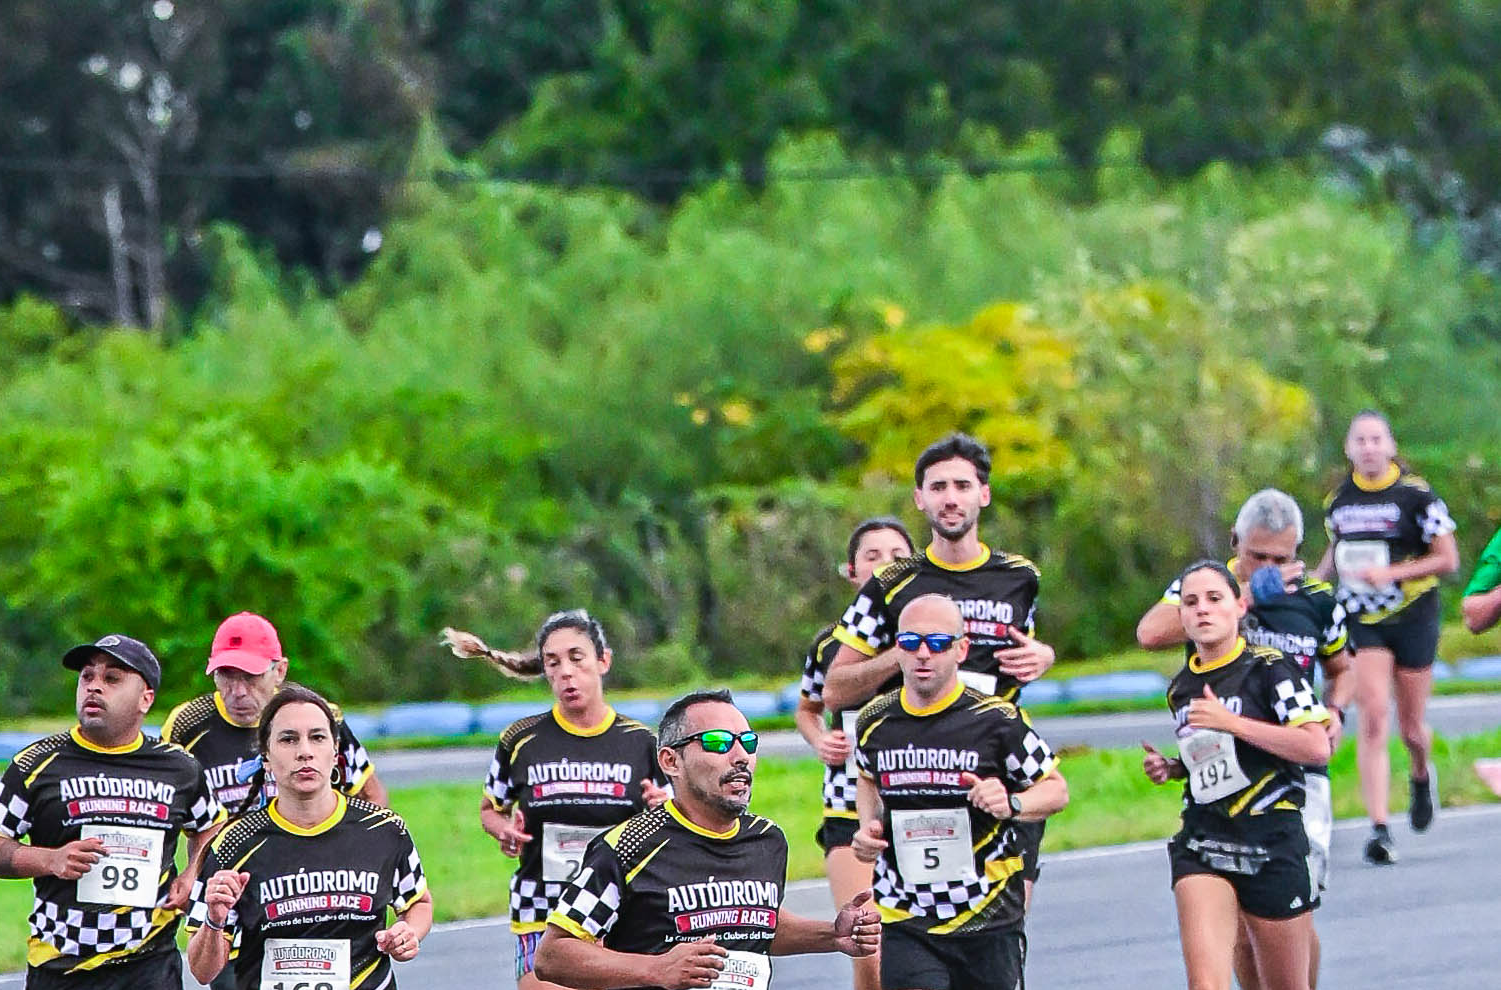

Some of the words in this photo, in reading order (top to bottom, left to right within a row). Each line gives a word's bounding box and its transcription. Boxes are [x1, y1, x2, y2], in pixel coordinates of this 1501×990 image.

[877, 743, 979, 772] AUTÓDROMO
[527, 757, 633, 786] AUTÓDROMO
[1199, 759, 1233, 790] 192
[59, 772, 177, 805] AUTÓDROMO
[129, 800, 159, 816] RACE
[923, 847, 940, 871] 5
[101, 865, 139, 891] 98
[259, 867, 379, 905] AUTÓDROMO
[276, 896, 328, 916] RUNNING
[329, 895, 361, 909] RACE
[667, 876, 778, 913] AUTÓDROMO
[689, 909, 739, 930] RUNNING
[740, 909, 770, 926] RACE
[723, 931, 749, 941] Clubes
[749, 930, 761, 940] del
